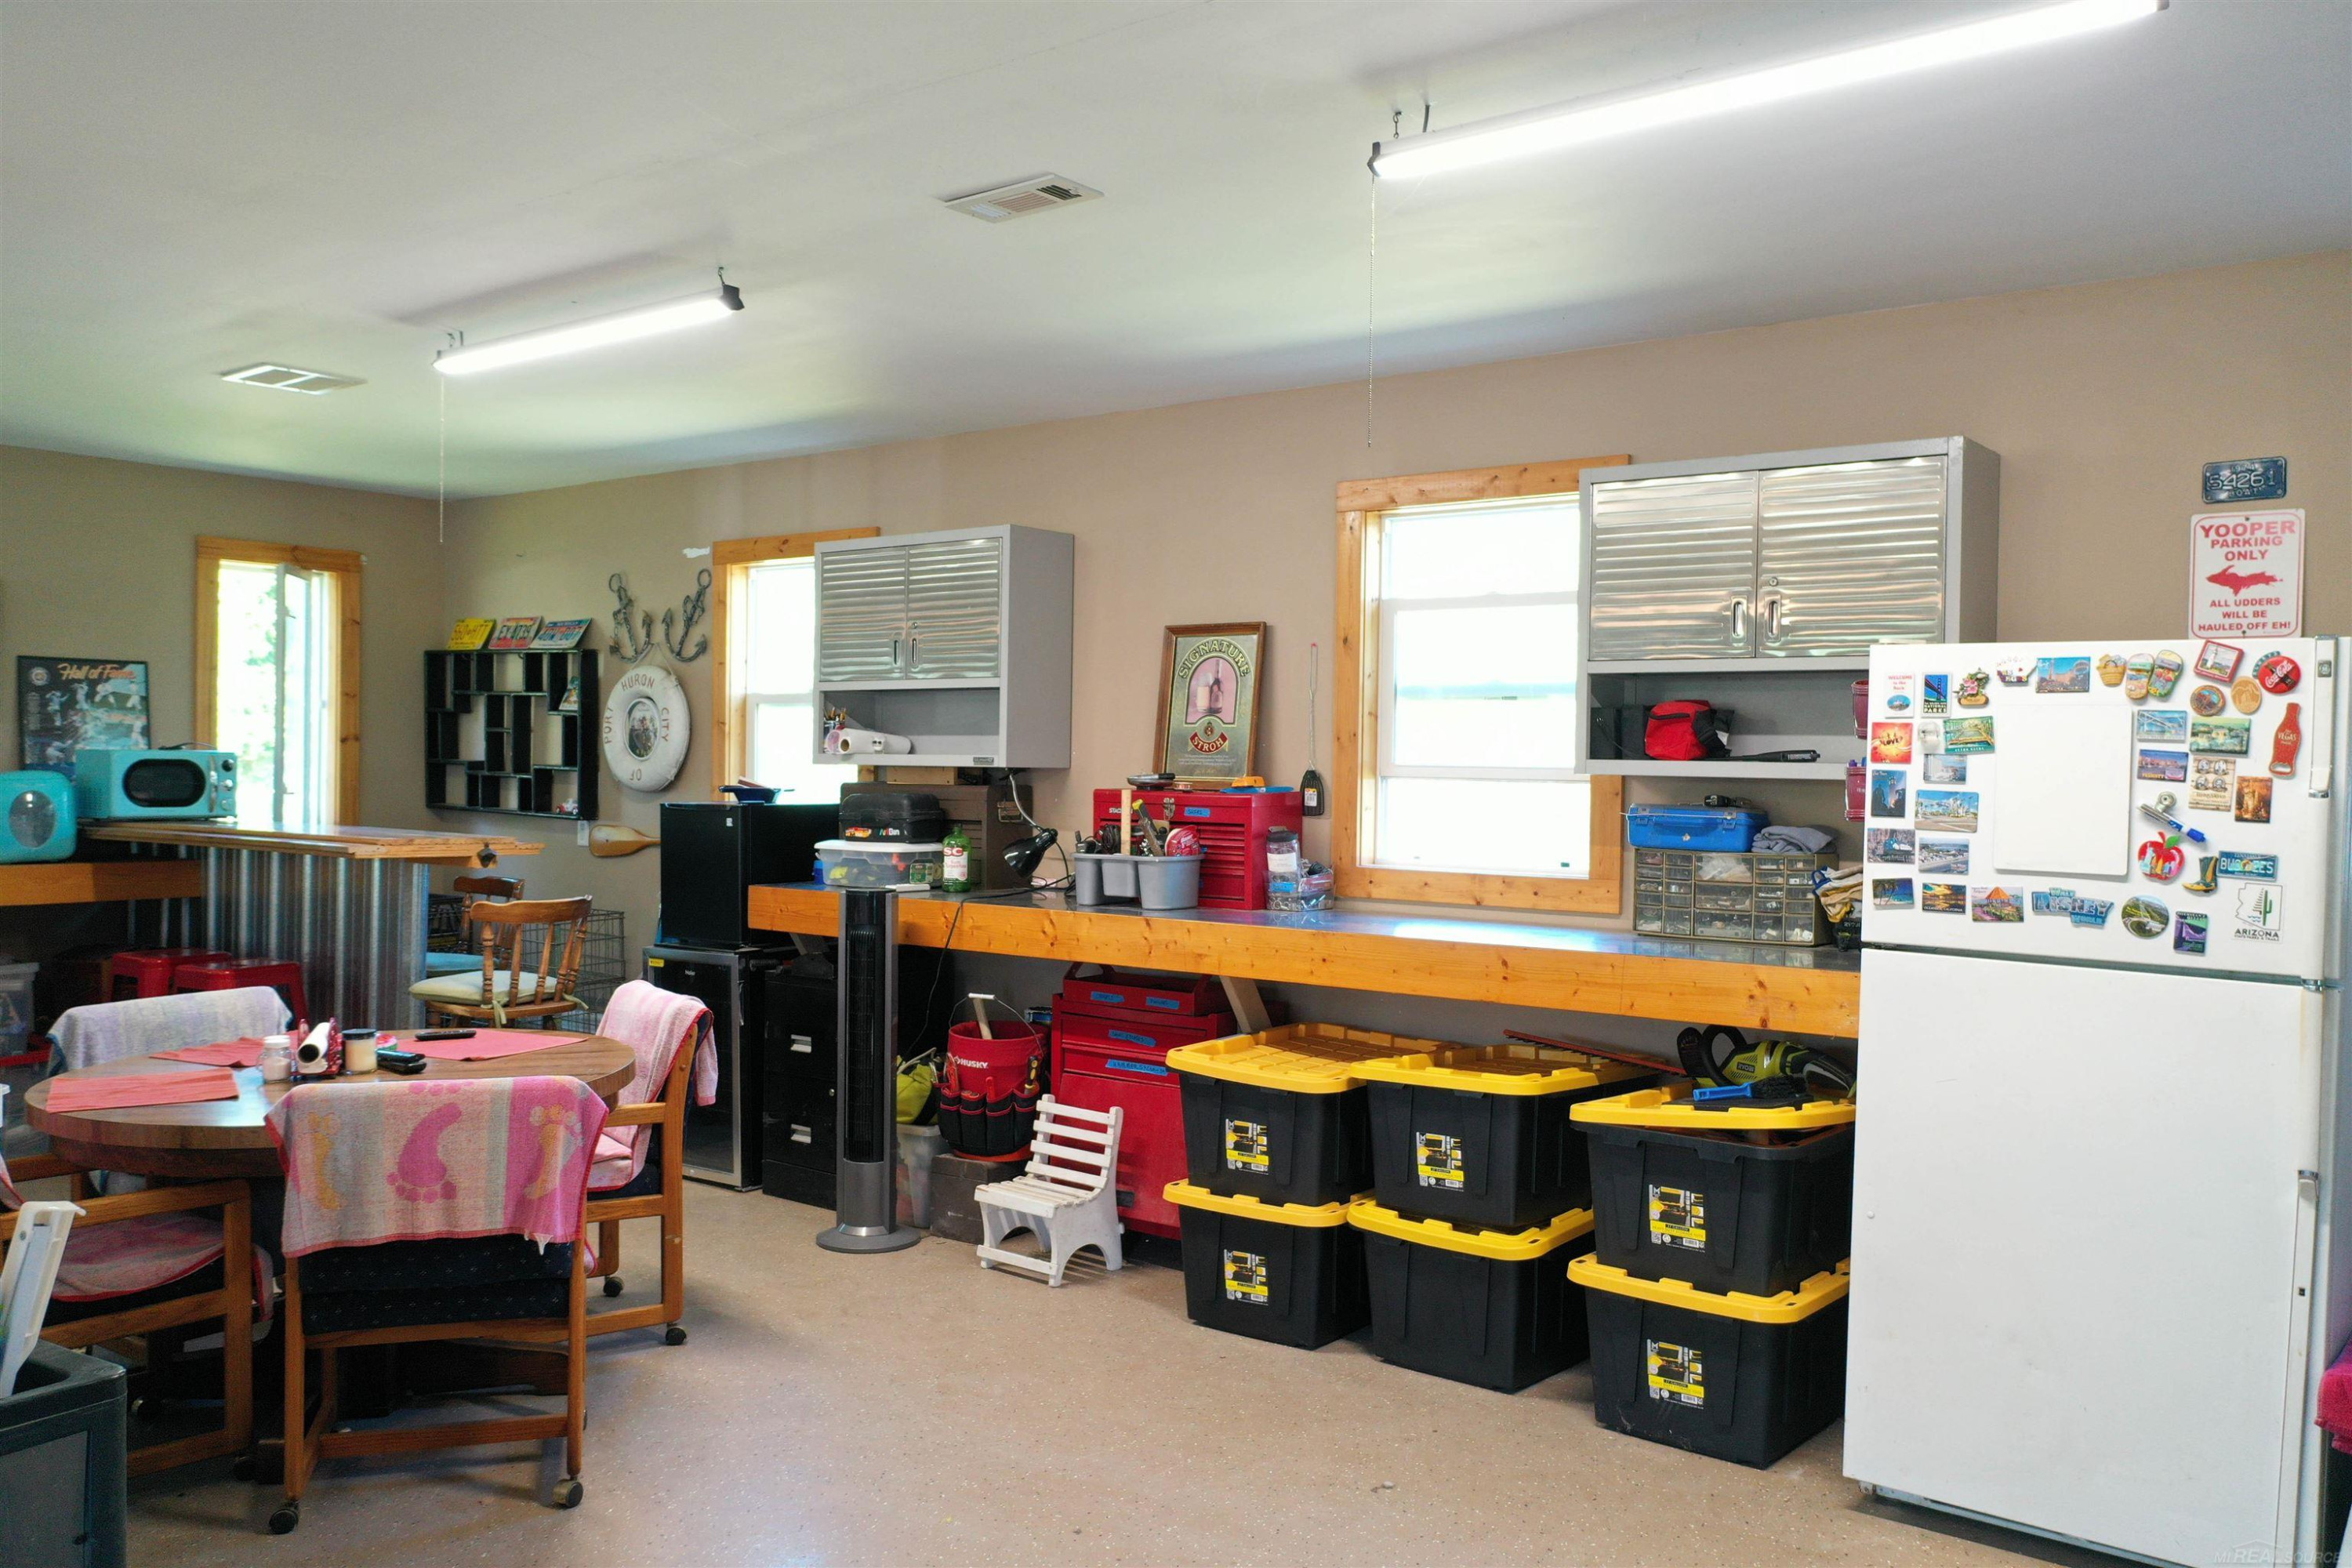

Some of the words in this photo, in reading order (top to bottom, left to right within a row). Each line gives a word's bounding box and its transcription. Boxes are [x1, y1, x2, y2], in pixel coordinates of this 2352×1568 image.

[2200, 521, 2296, 539] YOOPER
[2211, 535, 2283, 549] PARKING
[2224, 550, 2269, 561] ONLY
[2209, 599, 2230, 608] ALL
[2234, 597, 2281, 607] UDDERS
[2222, 610, 2250, 619] WILL
[2252, 610, 2267, 619] BE
[2198, 622, 2243, 632] HAULED
[2247, 622, 2267, 630] OFF
[2272, 621, 2290, 630] EH!
[1178, 639, 1250, 678] SIGNATURE
[57, 663, 89, 681] Hall
[90, 665, 103, 680] of
[102, 664, 136, 680] Fame
[620, 676, 655, 692] HURON
[661, 706, 670, 743] CITY
[2278, 731, 2296, 742] VEGAS
[1192, 736, 1223, 752] STROH
[2234, 928, 2279, 938] ARIZONA
[960, 1058, 989, 1069] HUSKY
